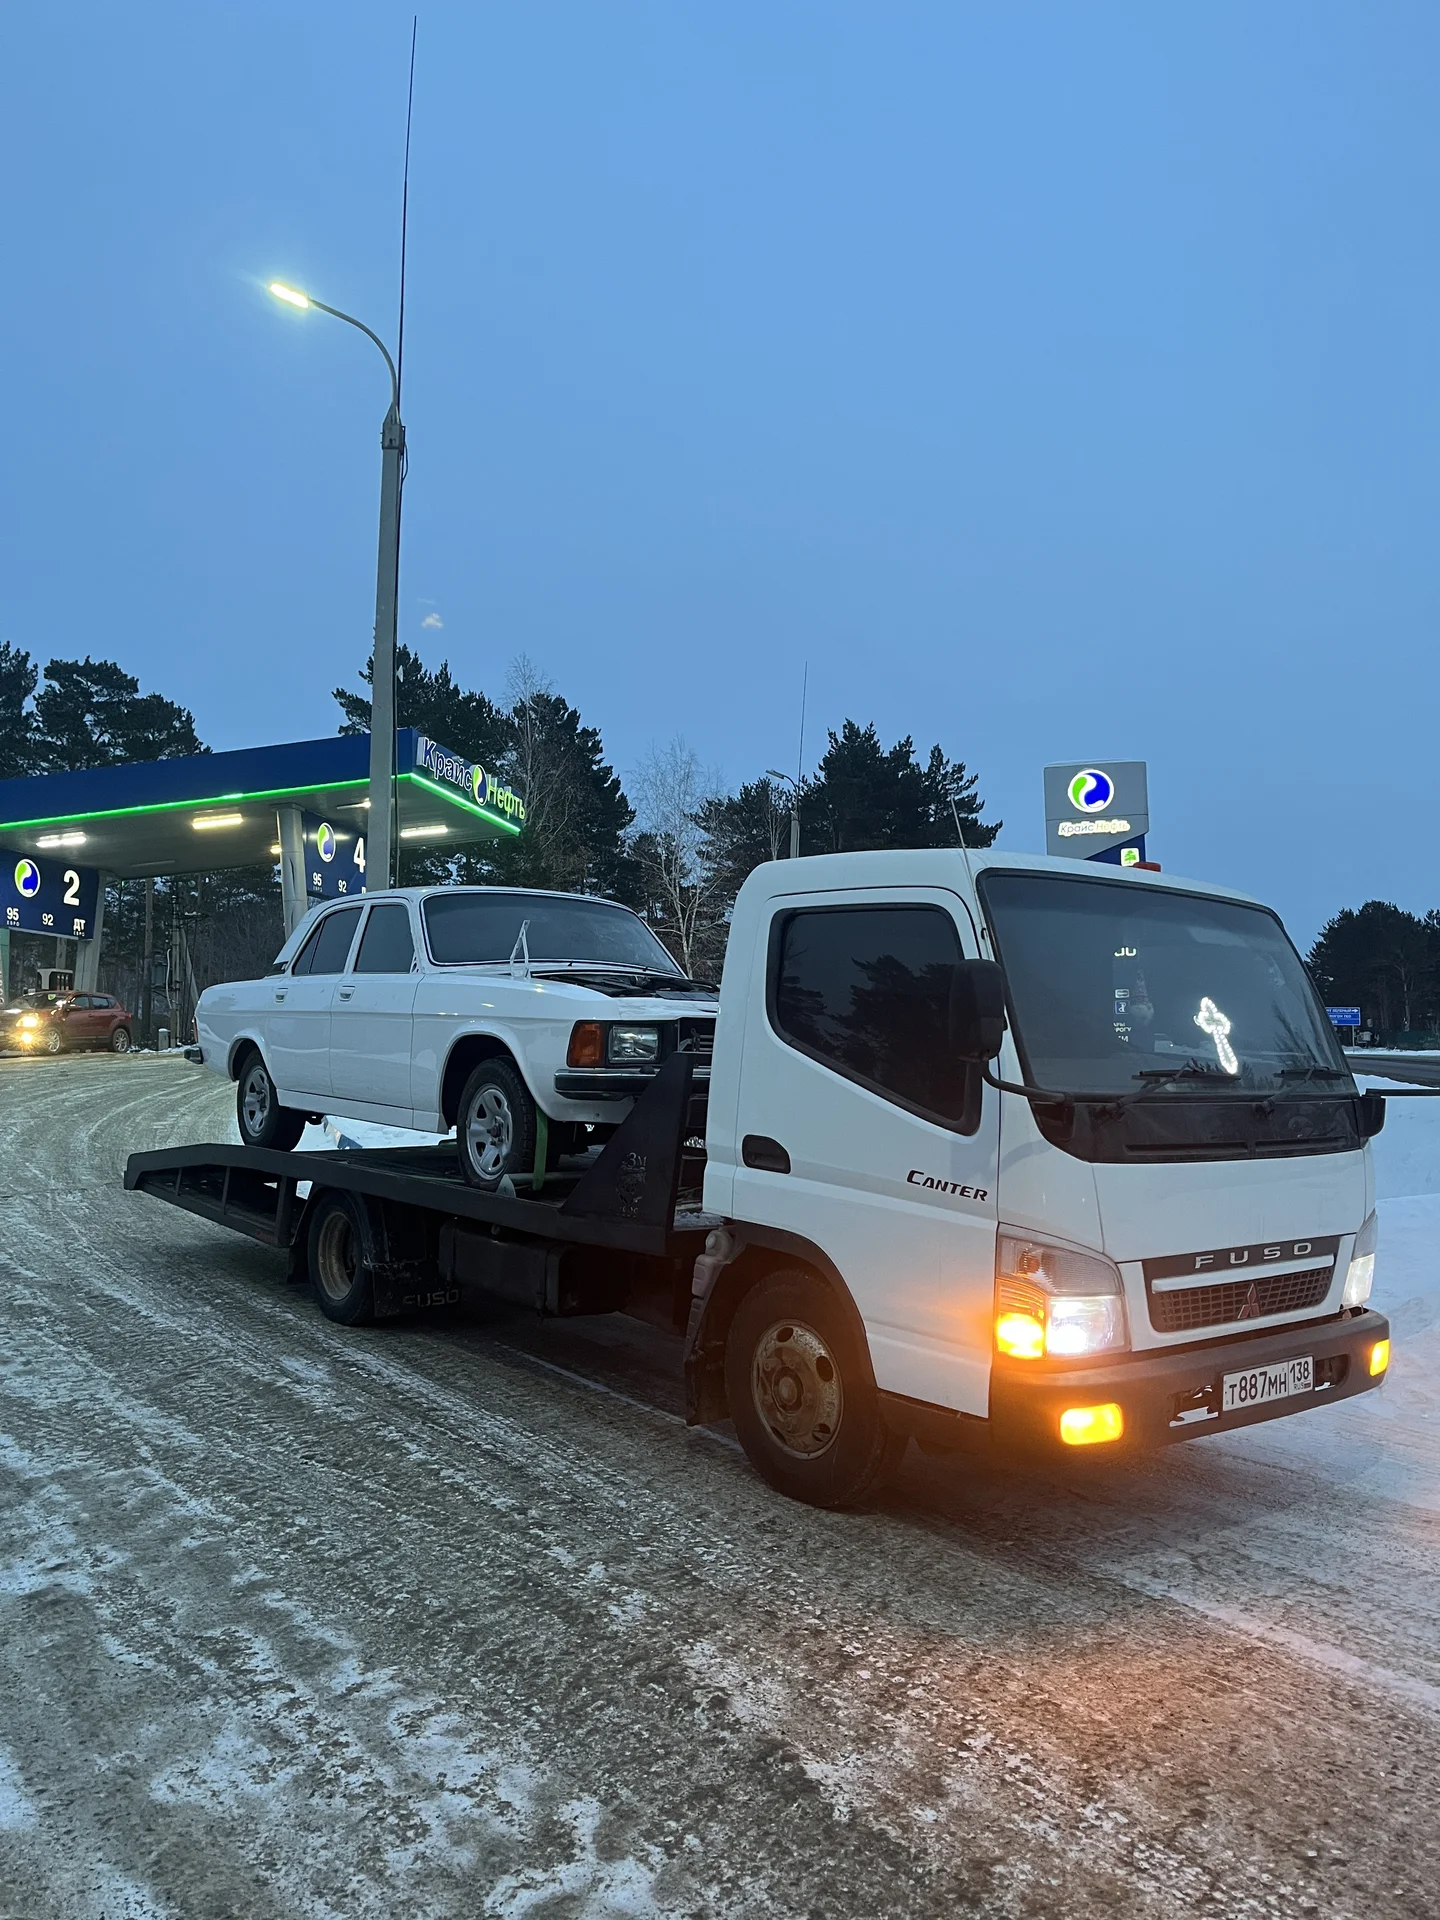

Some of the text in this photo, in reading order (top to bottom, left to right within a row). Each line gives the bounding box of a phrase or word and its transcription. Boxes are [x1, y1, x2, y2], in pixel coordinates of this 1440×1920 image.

[422, 737, 525, 820] Крайс Нефть
[1059, 821, 1095, 836] Крайс
[353, 836, 366, 873] 4
[63, 869, 80, 906] 2
[312, 872, 322, 887] 95
[338, 880, 347, 893] 92
[6, 907, 20, 920] 95
[42, 913, 54, 926] 92
[906, 1169, 988, 1202] CANTER
[1194, 1242, 1312, 1269] FUSO
[1290, 1360, 1311, 1383] 138
